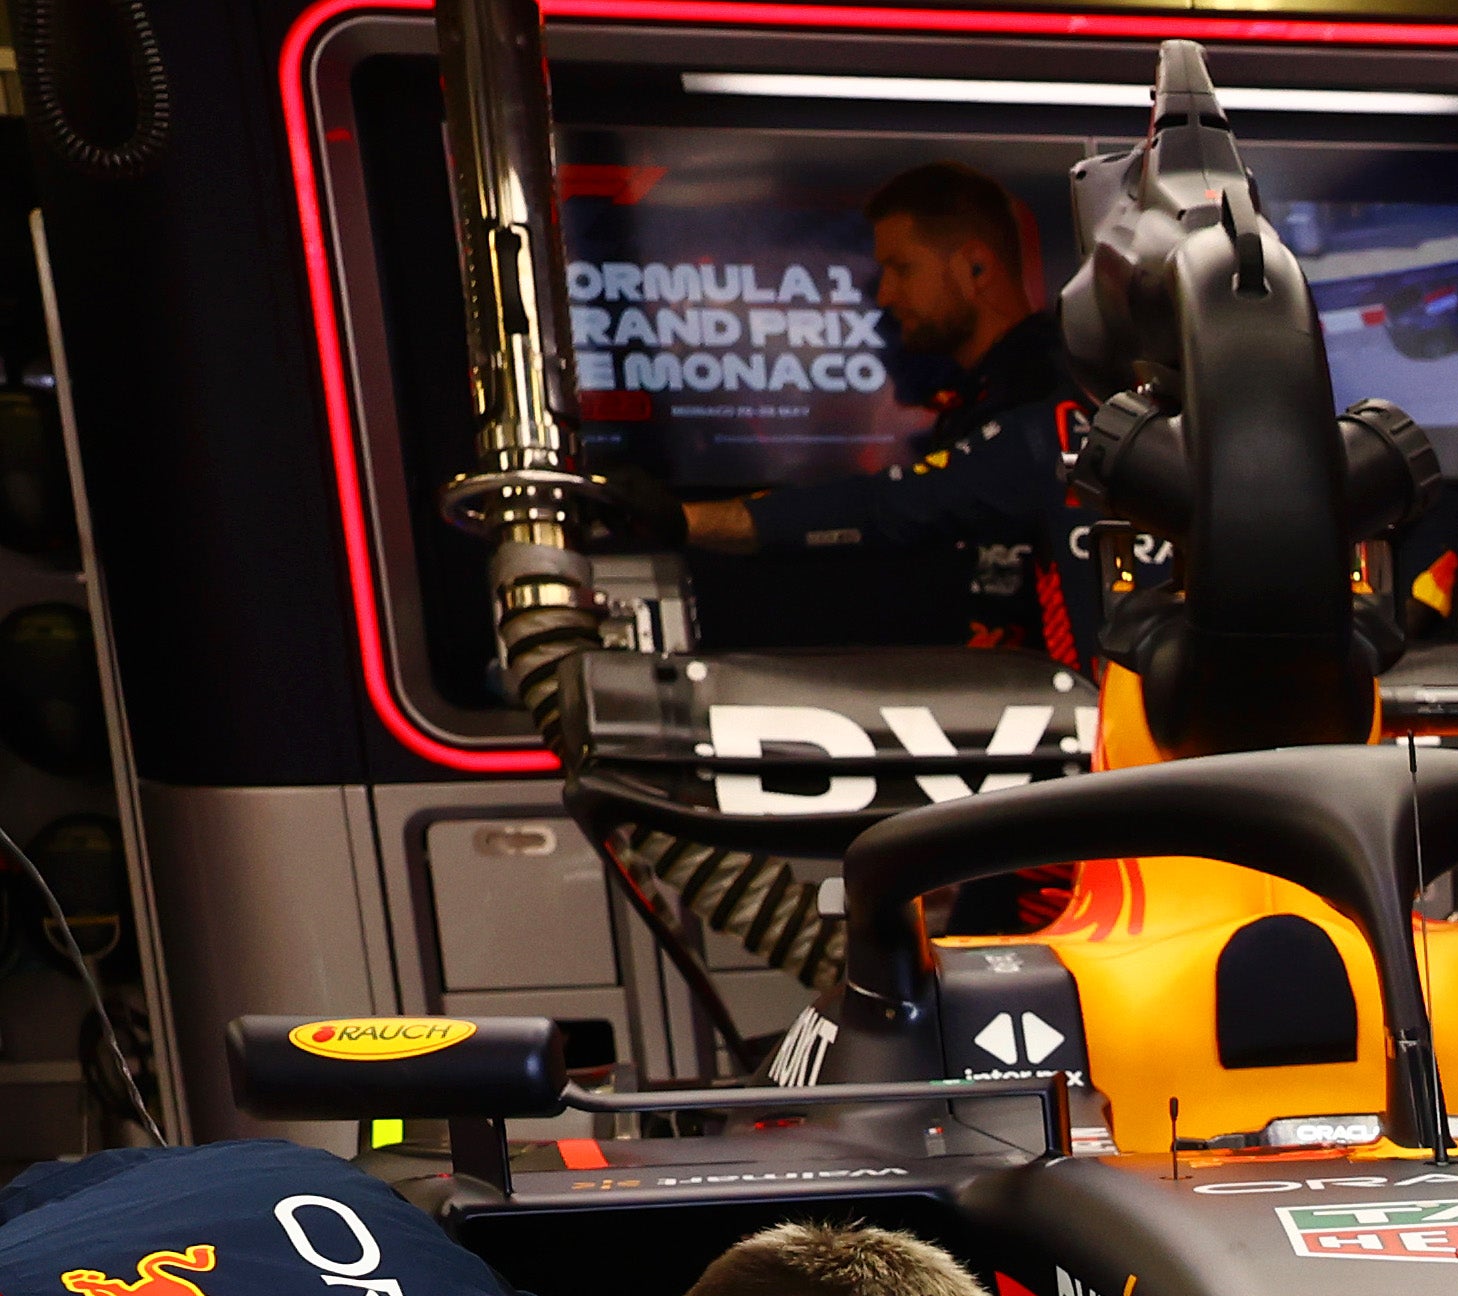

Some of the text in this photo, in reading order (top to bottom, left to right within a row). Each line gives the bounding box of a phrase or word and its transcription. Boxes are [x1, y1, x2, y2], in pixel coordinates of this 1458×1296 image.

[566, 260, 863, 305] ORMULA 1
[568, 306, 887, 348] RAND PRIX
[576, 351, 888, 392] E MONACO
[338, 1024, 451, 1042] RAUCH
